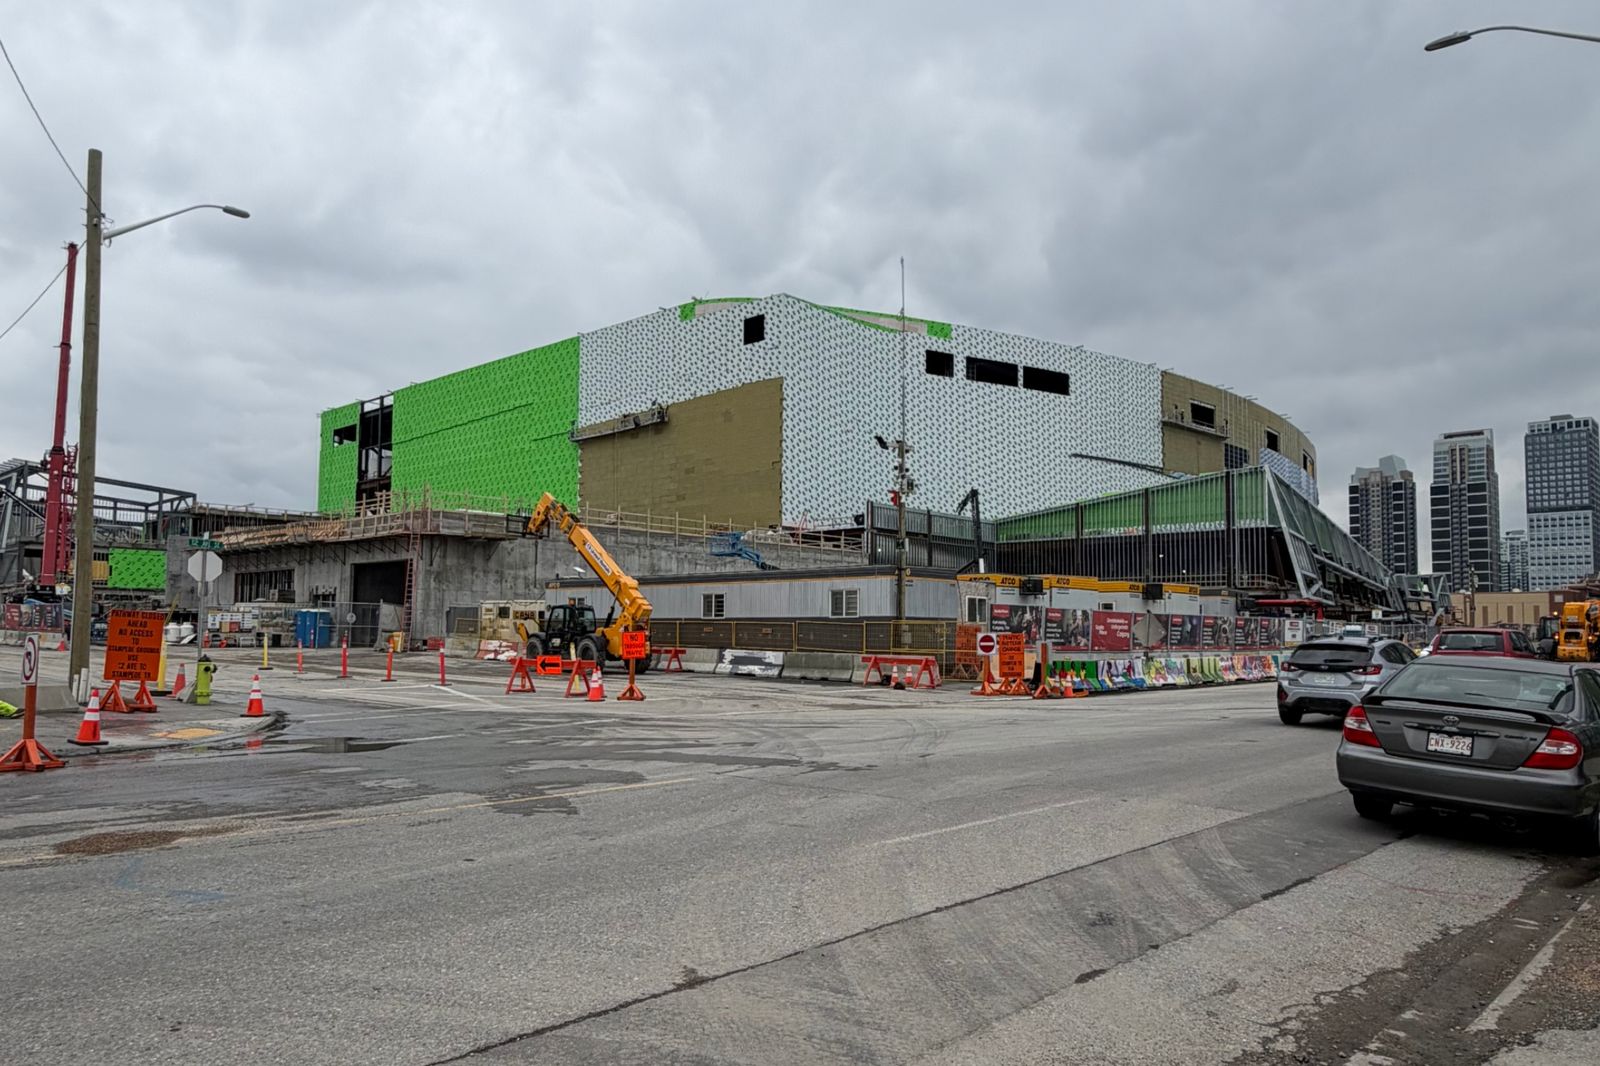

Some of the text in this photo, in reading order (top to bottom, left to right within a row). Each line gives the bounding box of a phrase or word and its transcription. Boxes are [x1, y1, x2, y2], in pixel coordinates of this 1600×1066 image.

[1000, 577, 1016, 586] ATCO
[1056, 578, 1070, 586] ATCO
[111, 609, 165, 621] PATHWAY CLOSED
[128, 620, 148, 628] AHEAD
[130, 629, 154, 637] ACCESS
[132, 637, 140, 645] TO
[112, 670, 141, 679] STAMPEDE
[1429, 737, 1472, 752] CNX-9226
